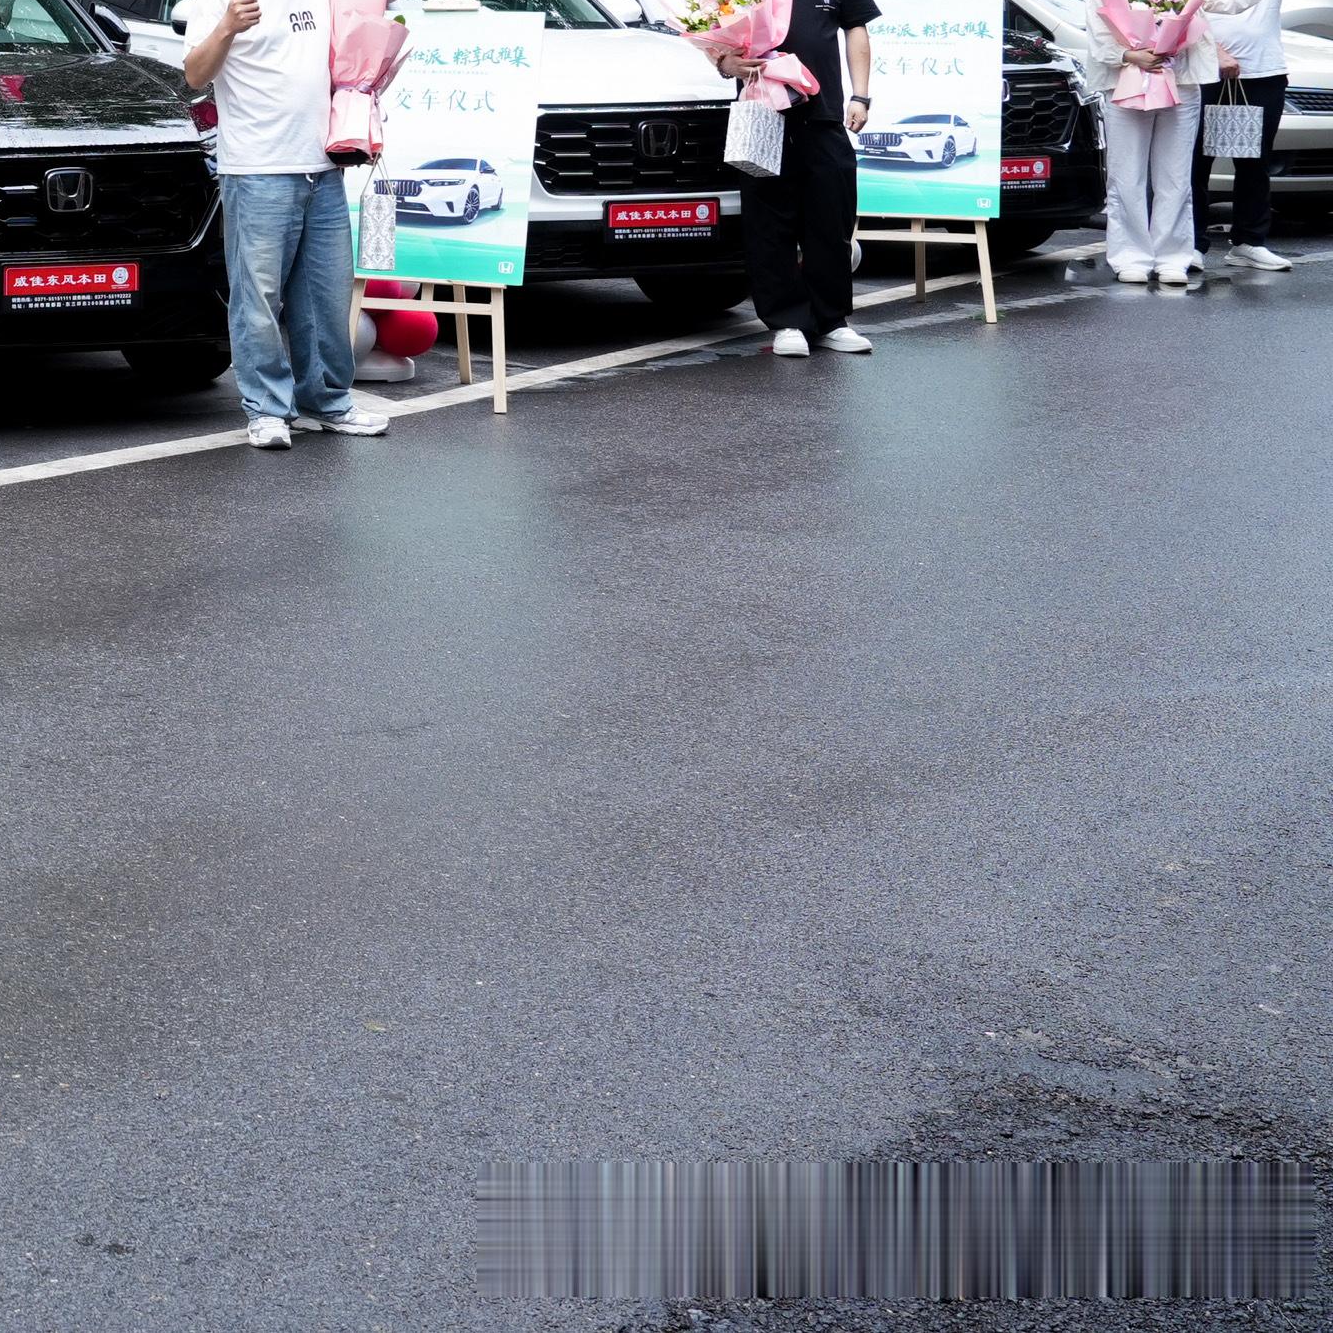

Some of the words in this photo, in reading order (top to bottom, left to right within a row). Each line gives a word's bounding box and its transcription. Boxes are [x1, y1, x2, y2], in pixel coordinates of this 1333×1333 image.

[408, 48, 449, 66] 仕派
[394, 88, 495, 113] 交车仪式
[13, 273, 107, 287] 威佳东风本田
